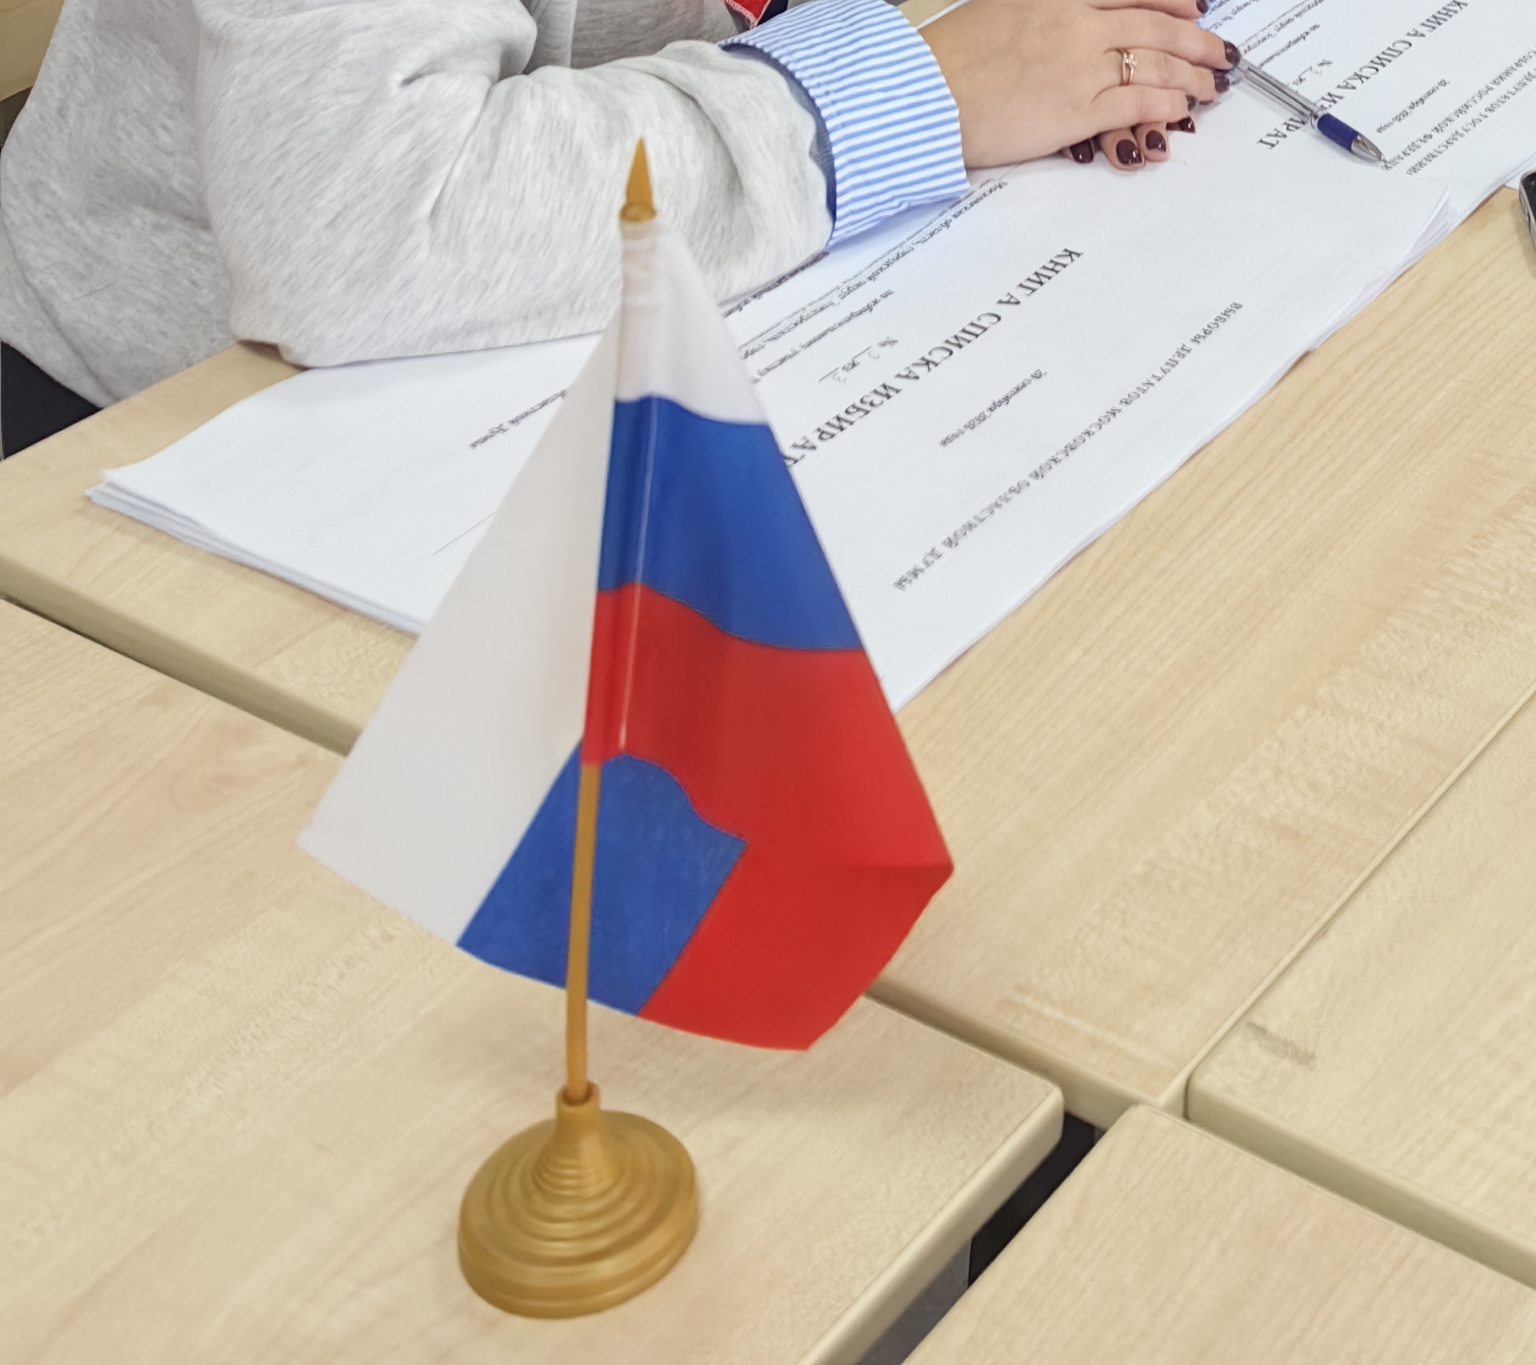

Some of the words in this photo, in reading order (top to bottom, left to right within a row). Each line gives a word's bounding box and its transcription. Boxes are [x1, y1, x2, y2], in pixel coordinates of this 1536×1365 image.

[1333, 35, 1414, 95] СПИСКА
[993, 245, 1086, 311] КНИГА
[892, 307, 1004, 387] СПИСКА
[1187, 301, 1246, 346] ВЫБОРЫ
[1113, 343, 1198, 408] ДЕПУТАТОВ
[1026, 404, 1127, 483] МОСКОВСКОЙ
